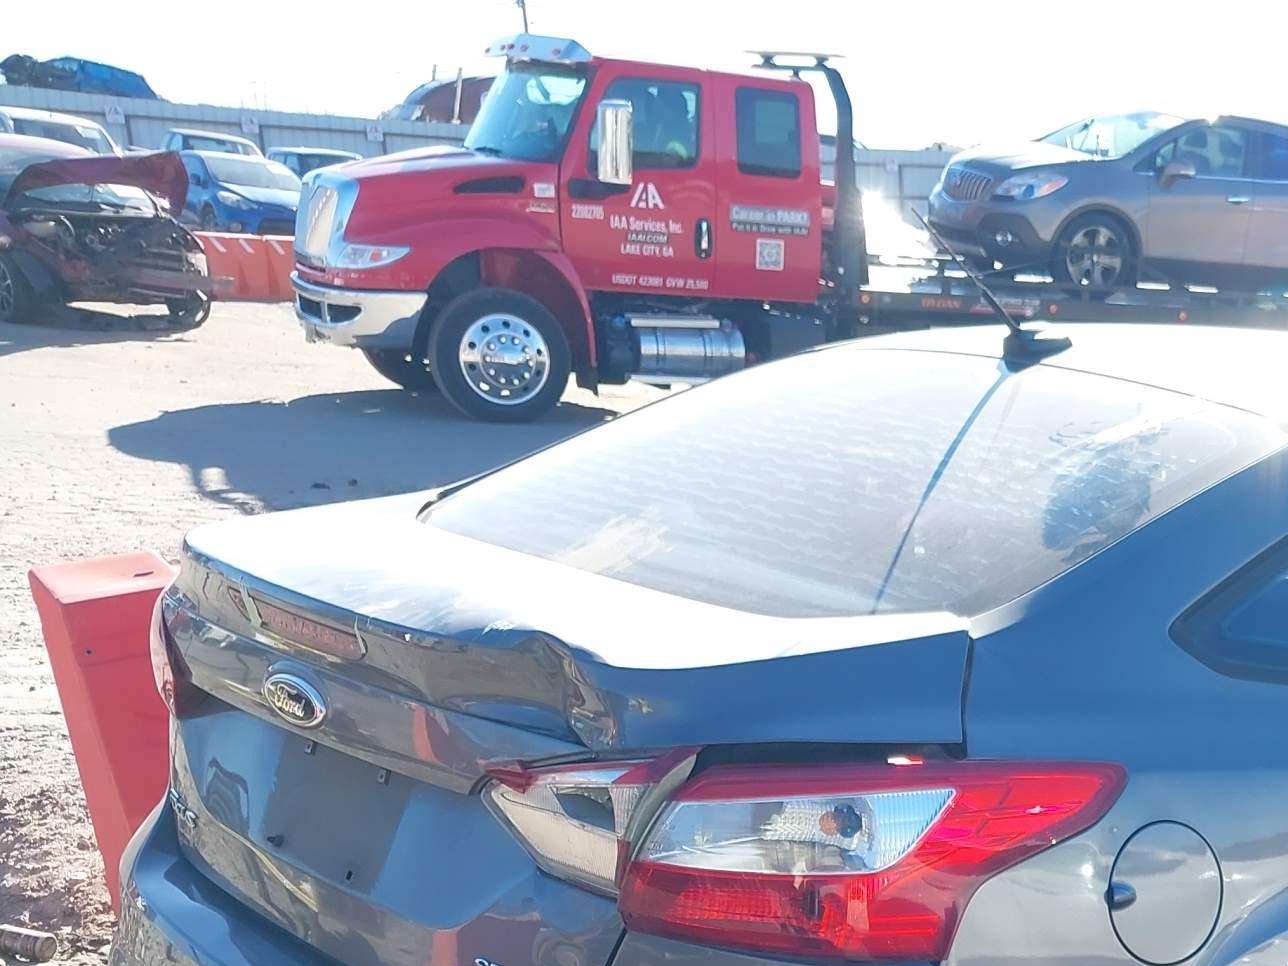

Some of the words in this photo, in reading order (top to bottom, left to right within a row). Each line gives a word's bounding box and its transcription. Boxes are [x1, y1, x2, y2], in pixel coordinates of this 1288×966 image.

[610, 215, 627, 230] IAA
[621, 243, 640, 255] LAKE
[275, 684, 305, 717] Ford
